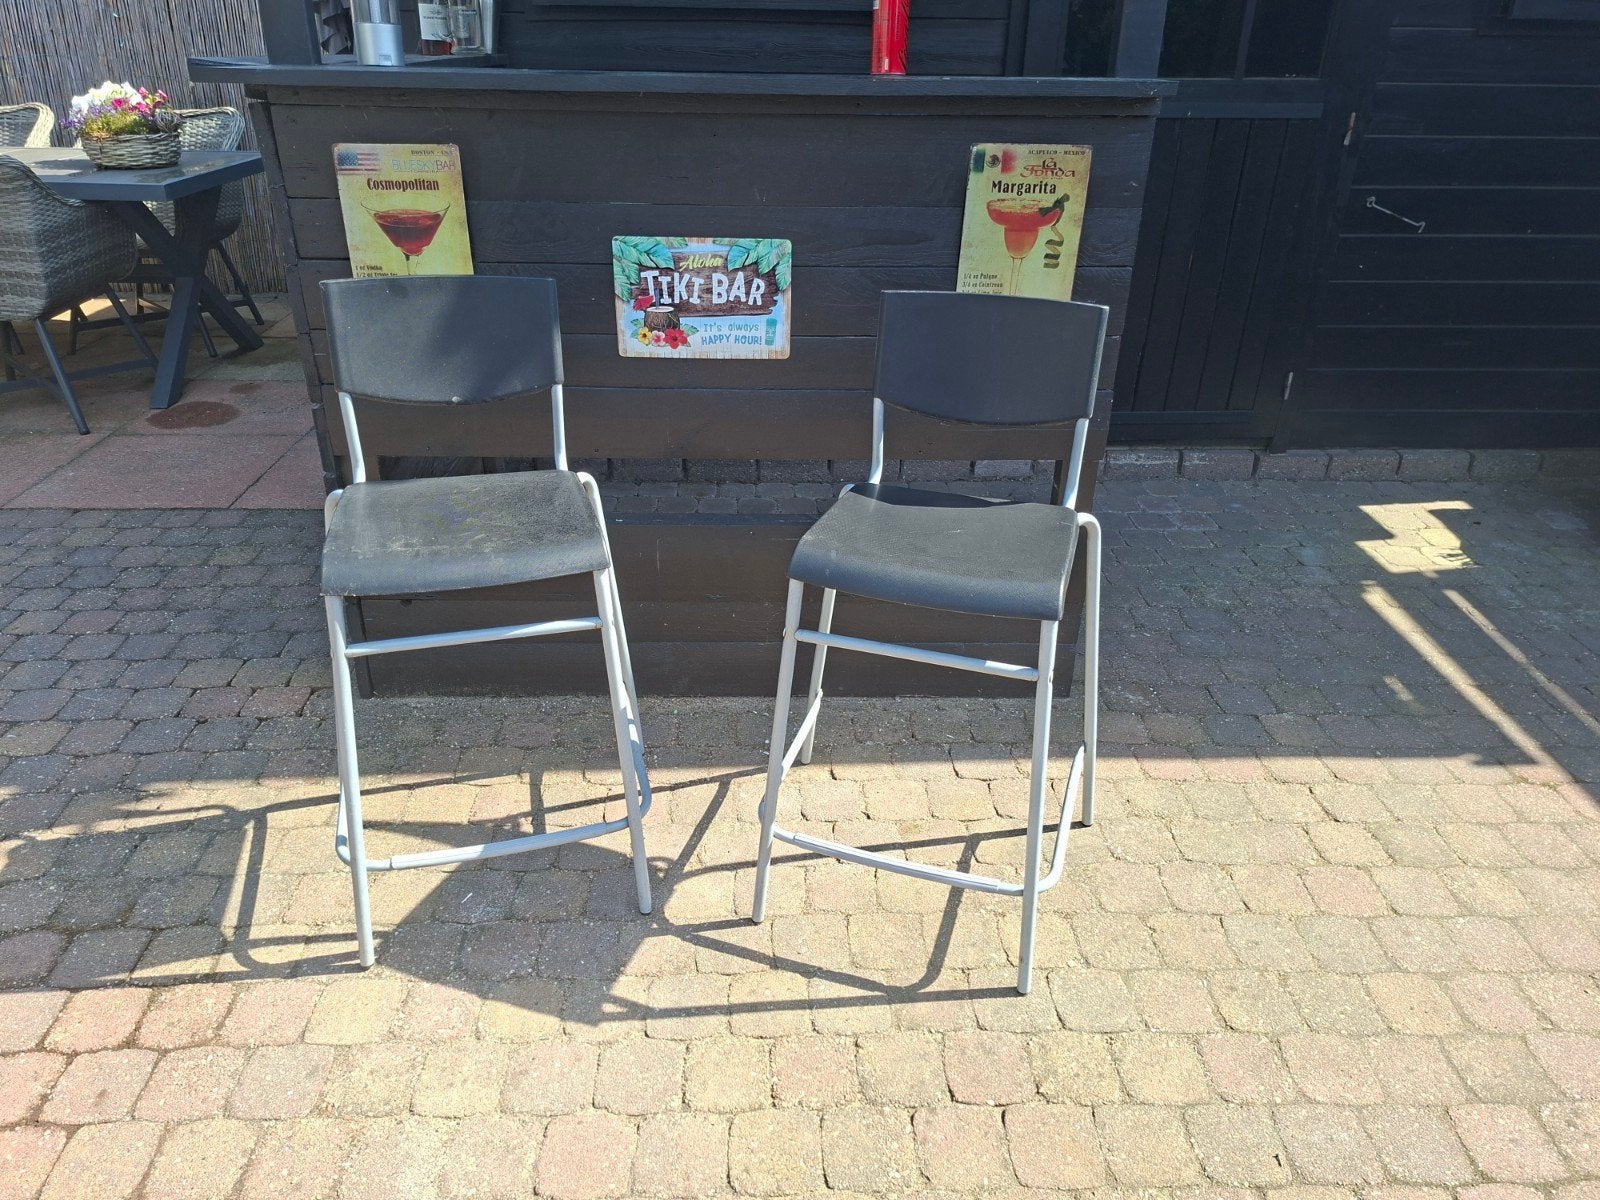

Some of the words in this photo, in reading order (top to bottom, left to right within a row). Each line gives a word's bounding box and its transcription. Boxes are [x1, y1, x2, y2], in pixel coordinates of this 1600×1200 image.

[367, 179, 440, 192] Cosmopolitan
[991, 180, 1057, 197] Margarita
[680, 254, 724, 270] Aloha
[640, 270, 705, 305] TIKI
[711, 271, 766, 306] BAR
[703, 322, 722, 333] It's
[727, 322, 760, 333] always
[701, 333, 732, 346] HAPPY
[734, 333, 763, 346] HOUR!
